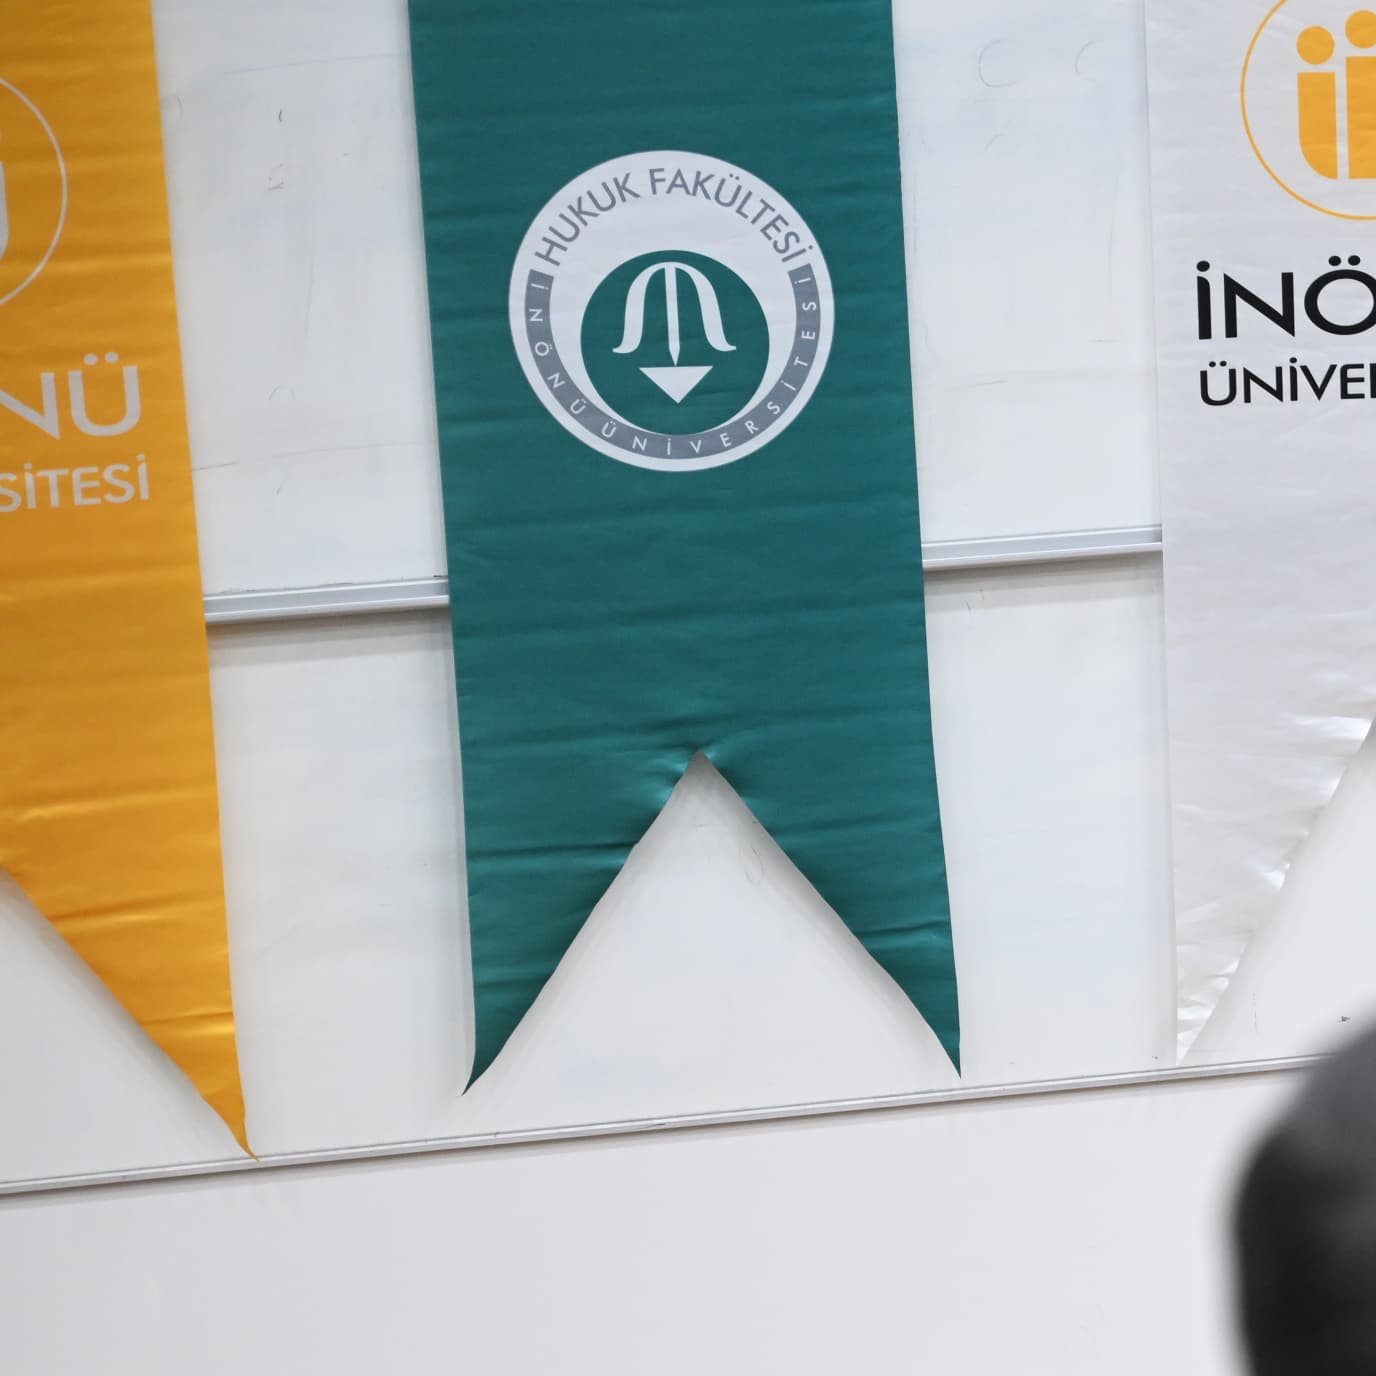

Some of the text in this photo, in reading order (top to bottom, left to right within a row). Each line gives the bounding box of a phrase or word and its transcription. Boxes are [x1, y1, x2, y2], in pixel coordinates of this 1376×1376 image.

[534, 168, 814, 266] HUKUK FAKÜLTESİ
[528, 276, 817, 456] İNÖNÜ ÜNİVERSİTESİ
